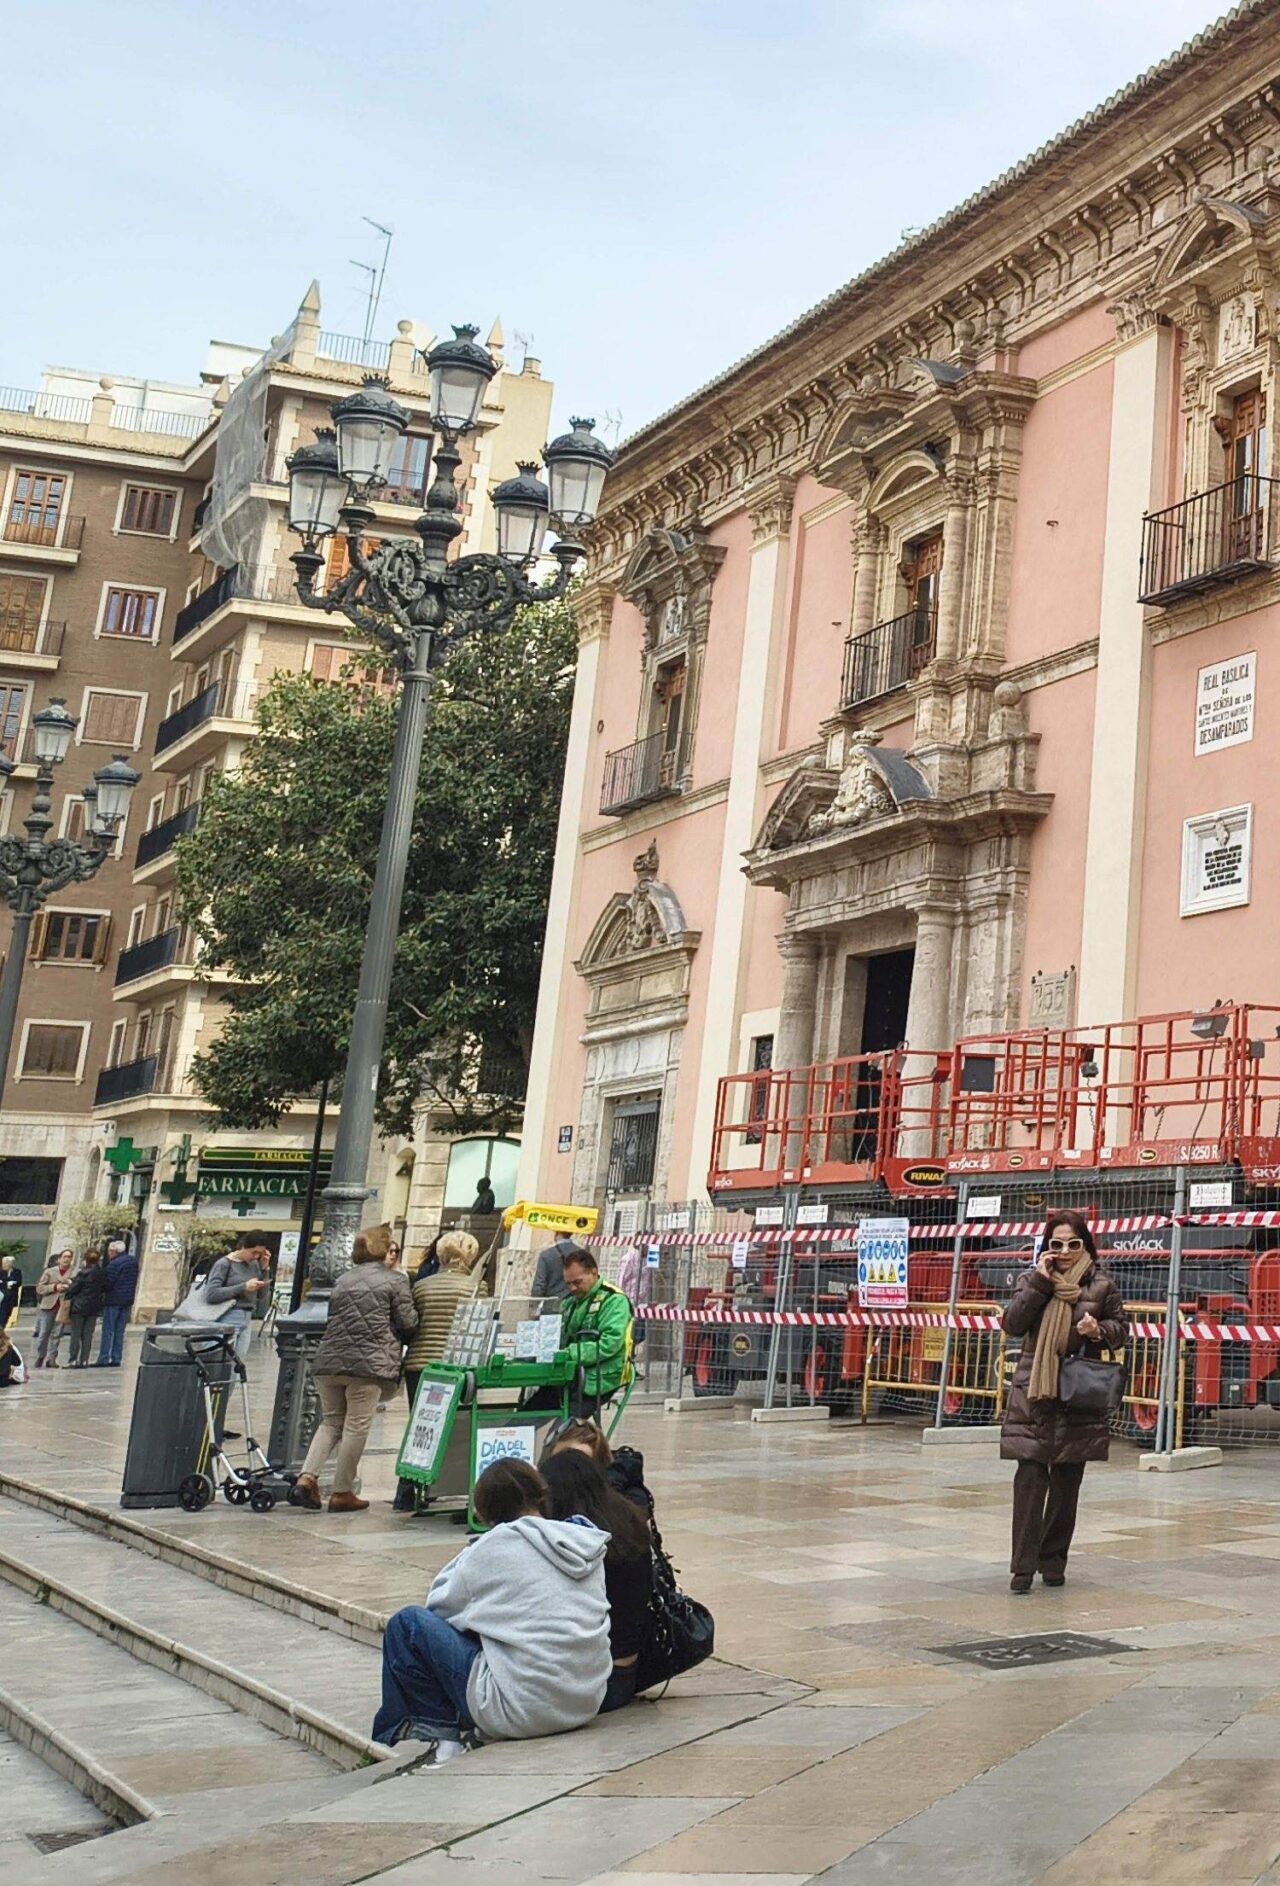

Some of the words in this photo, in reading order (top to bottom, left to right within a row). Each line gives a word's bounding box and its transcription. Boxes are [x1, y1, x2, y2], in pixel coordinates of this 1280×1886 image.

[1203, 674, 1219, 691] REAL
[1221, 663, 1249, 685] BASILICA
[1200, 717, 1249, 746] DESAMPARADOS
[255, 1151, 305, 1161] FARMACIA
[198, 1176, 300, 1194] FARMACIA
[540, 1213, 570, 1225] ONCE
[1113, 1233, 1164, 1250] SKYJACK
[481, 1439, 507, 1458] DÍA
[507, 1440, 527, 1451] DEL
